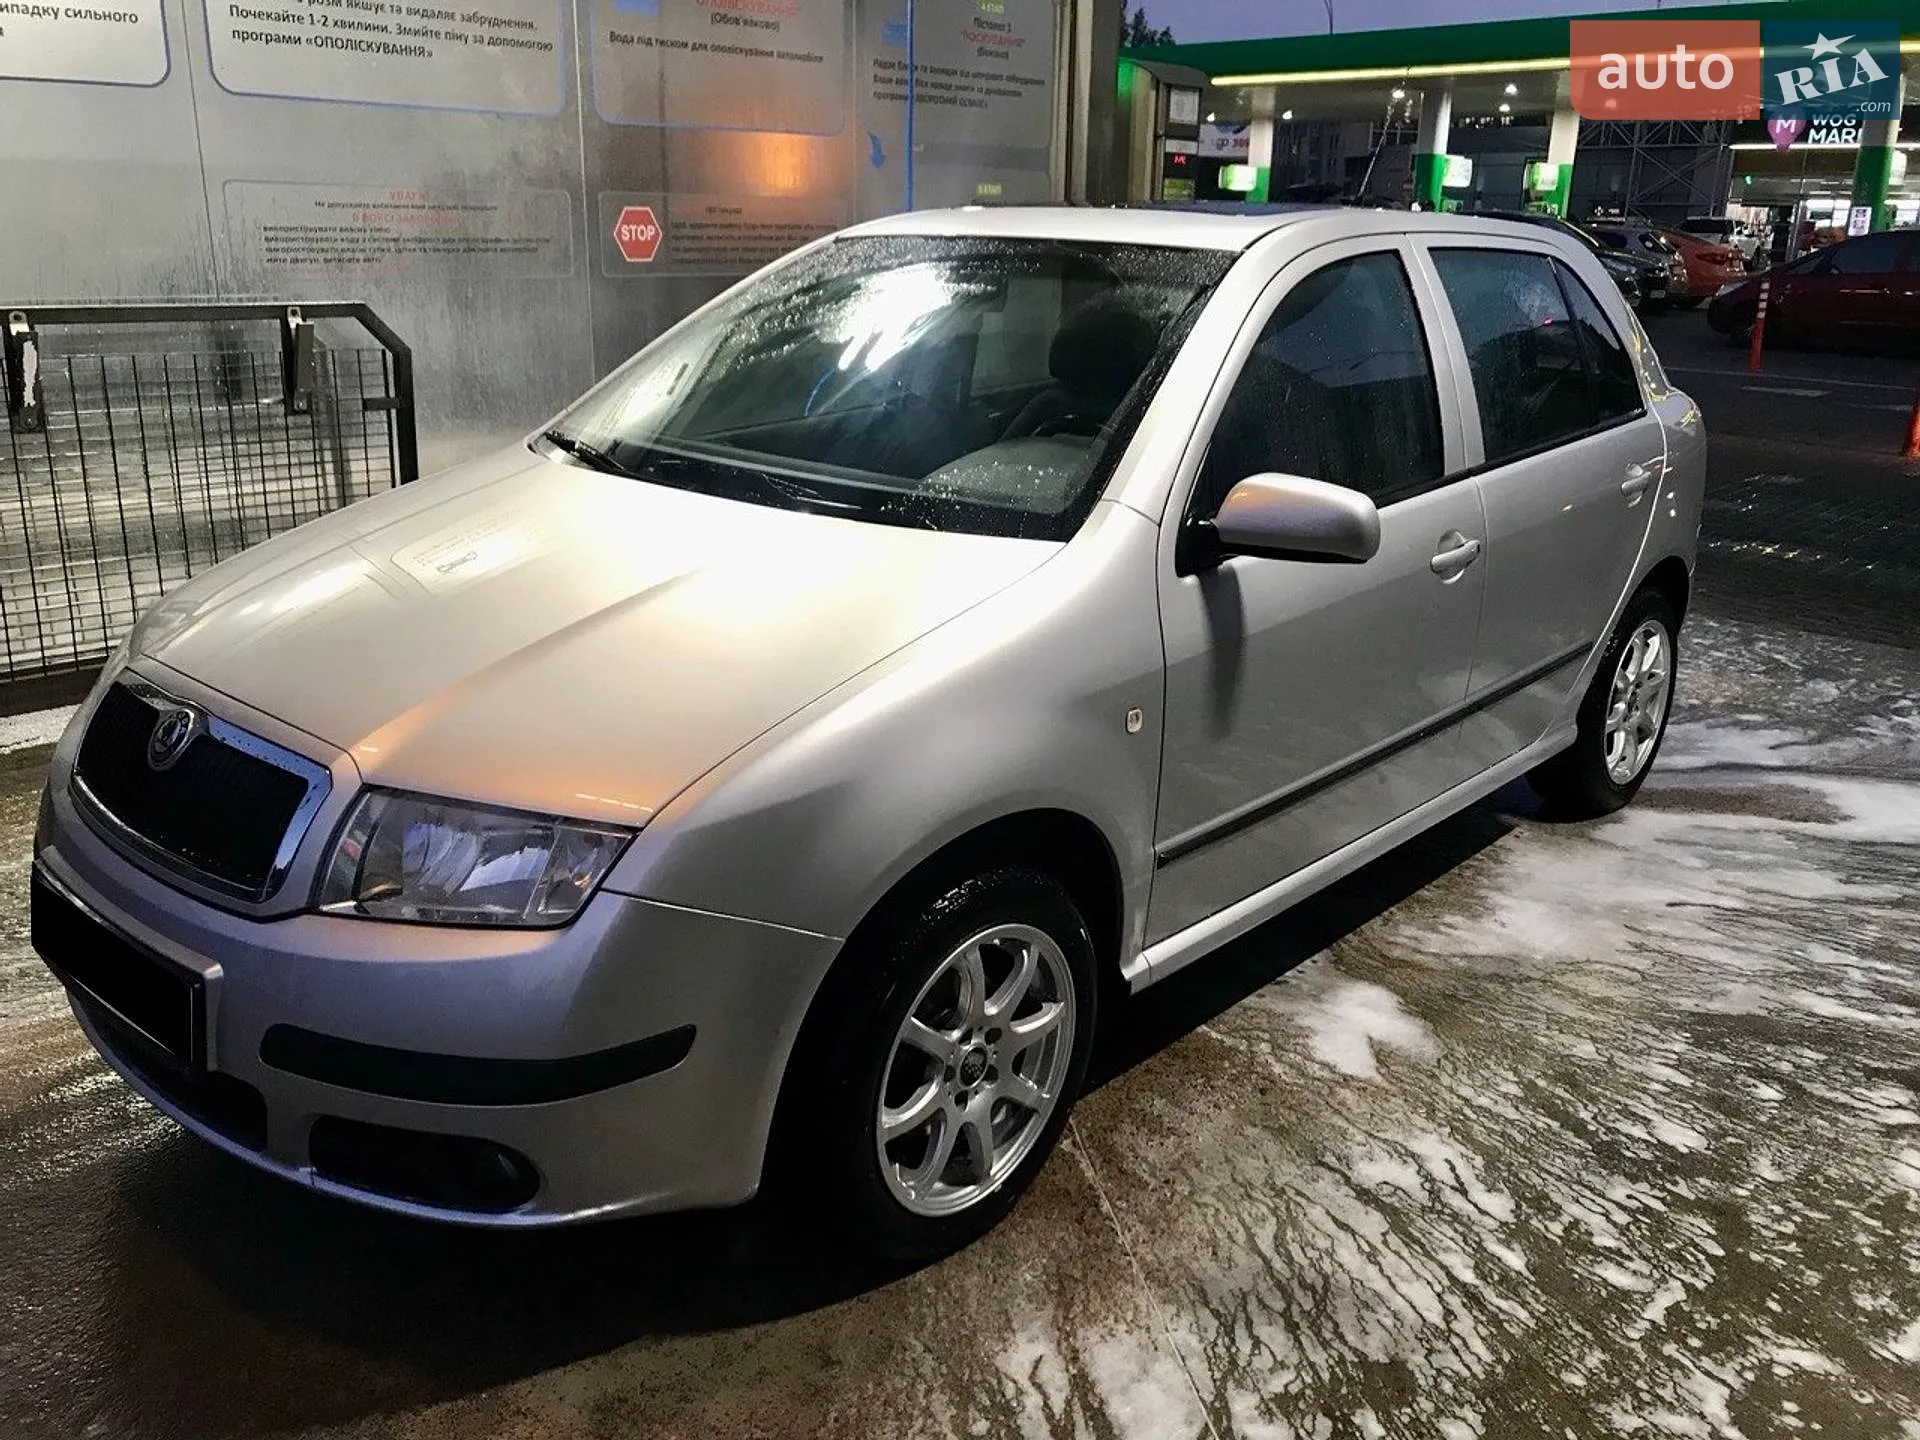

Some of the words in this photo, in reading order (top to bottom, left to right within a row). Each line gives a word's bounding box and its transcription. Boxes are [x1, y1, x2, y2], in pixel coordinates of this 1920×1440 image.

[65, 7, 139, 24] сильного
[389, 5, 402, 14] та
[406, 6, 456, 21] видаляє
[229, 4, 305, 24] Почекайте
[309, 13, 329, 28] 1-2
[333, 18, 393, 35] хвилини.
[395, 23, 441, 40] Змийте
[444, 31, 469, 45] піну
[471, 35, 484, 45] за
[487, 35, 553, 52] допомогою
[232, 28, 302, 46] програми
[306, 35, 433, 59] «ОПОЛІСКУВАННЯ»
[609, 30, 634, 44] Вода
[637, 35, 653, 48] під
[691, 42, 708, 52] для
[1812, 113, 1857, 127] WOG
[621, 225, 656, 241] STOP
